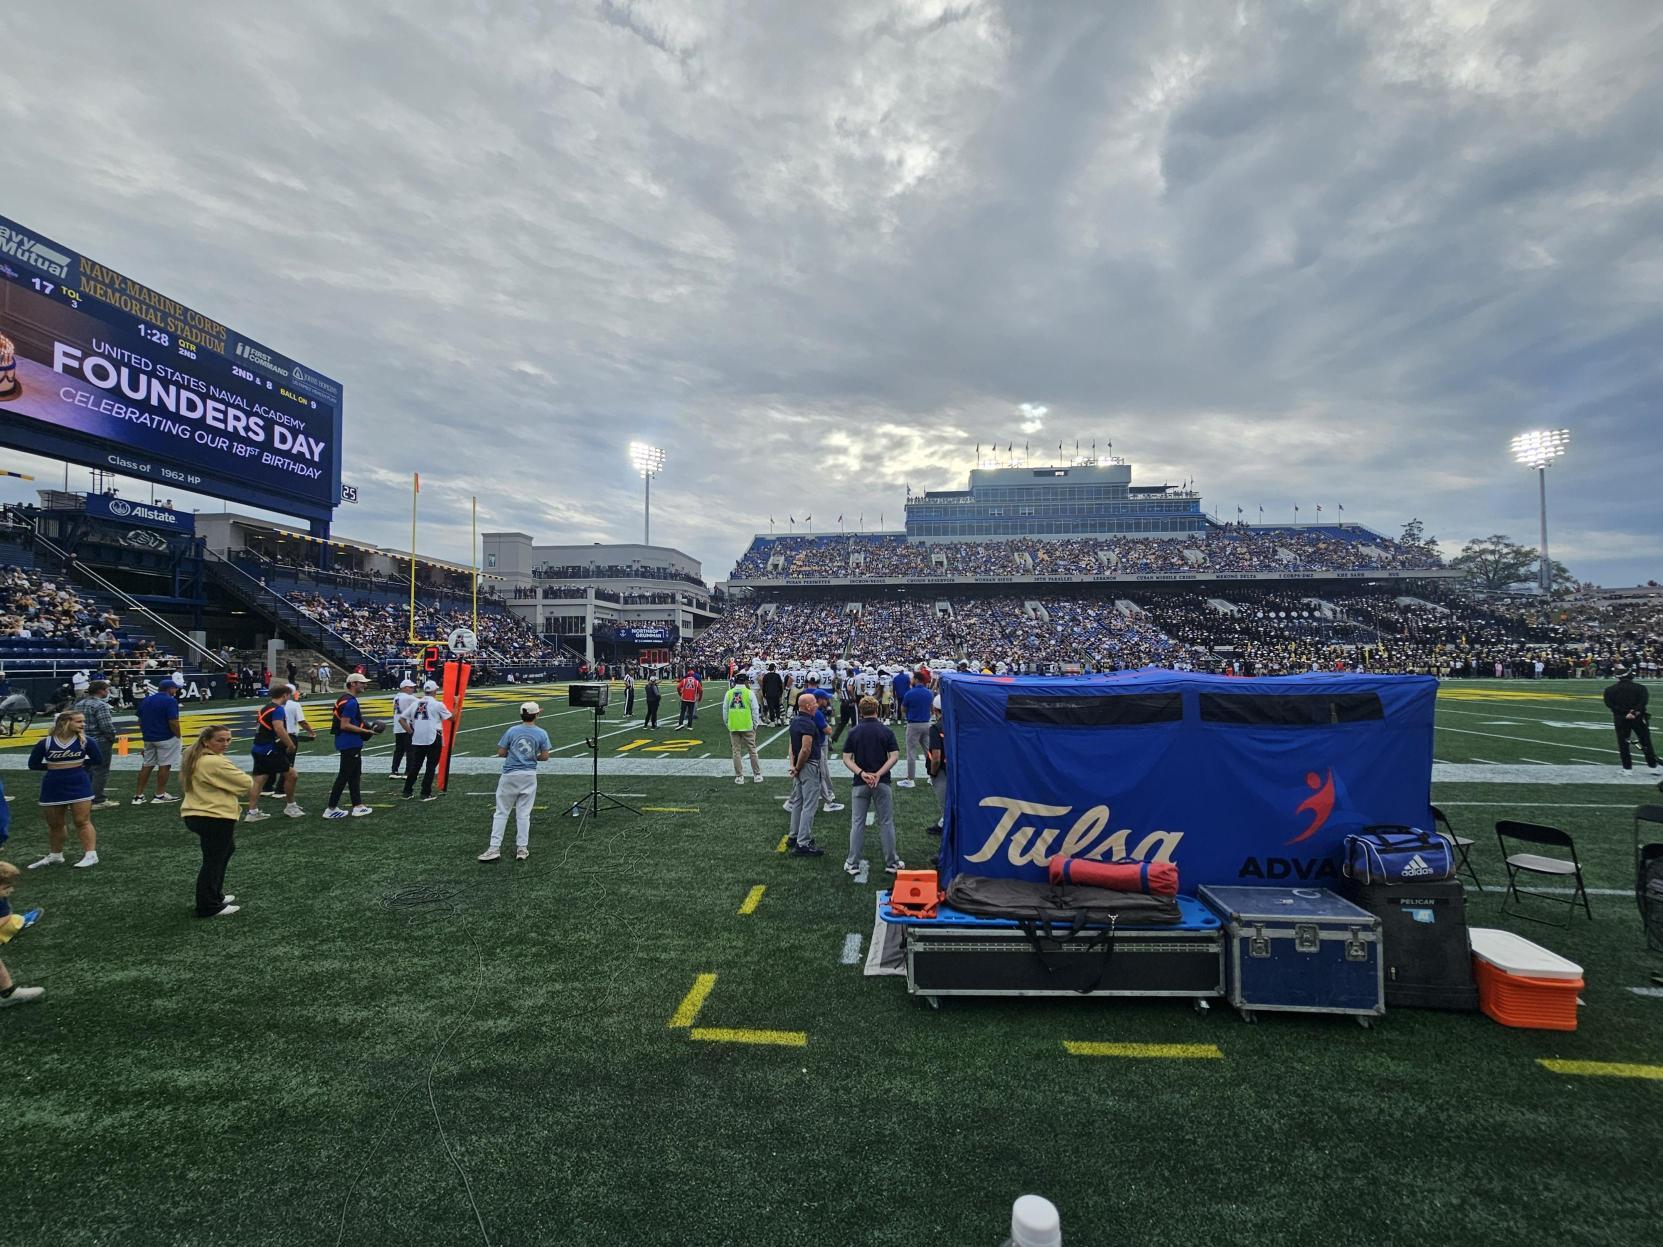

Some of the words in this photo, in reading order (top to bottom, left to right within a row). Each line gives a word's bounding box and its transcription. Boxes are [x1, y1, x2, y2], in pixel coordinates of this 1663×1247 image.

[0, 226, 36, 250] avy
[0, 238, 68, 278] Mutual
[32, 278, 54, 294] 17
[60, 286, 82, 302] TOL
[71, 300, 78, 308] 3
[80, 256, 184, 318] NAVY-MARINE
[187, 310, 226, 340] CORPS
[80, 276, 164, 328] MEMORIAL
[167, 316, 225, 355] STADIUM
[138, 324, 169, 347] 1:28
[178, 339, 196, 352] QTR
[178, 348, 196, 360] 2ND
[249, 354, 288, 377] COMMAND
[250, 348, 272, 362] FIRST
[92, 338, 152, 371] UNITED
[156, 364, 206, 393] STATES
[209, 385, 250, 410] NAVAL
[252, 404, 306, 431] ACADEMY
[232, 366, 254, 381] 2ND
[266, 381, 273, 390] 8
[53, 340, 266, 442] FOUNDERS
[273, 424, 325, 462] DAY
[280, 388, 297, 401] BALL
[298, 397, 308, 405] ON
[311, 400, 316, 409] 9
[60, 387, 191, 439] CELEBRATING
[194, 431, 229, 451] OUR
[232, 442, 260, 458] 181ST
[262, 452, 322, 480] BIRTHDAY
[108, 455, 137, 470] Class
[139, 464, 151, 472] of
[161, 468, 184, 481] 1962
[187, 475, 201, 485] HP
[343, 486, 355, 500] 25
[131, 506, 176, 523] Allstate
[425, 648, 438, 671] 2
[48, 750, 82, 759] Tulsa
[964, 796, 1184, 867] Tulsa
[1401, 868, 1434, 876] adidas
